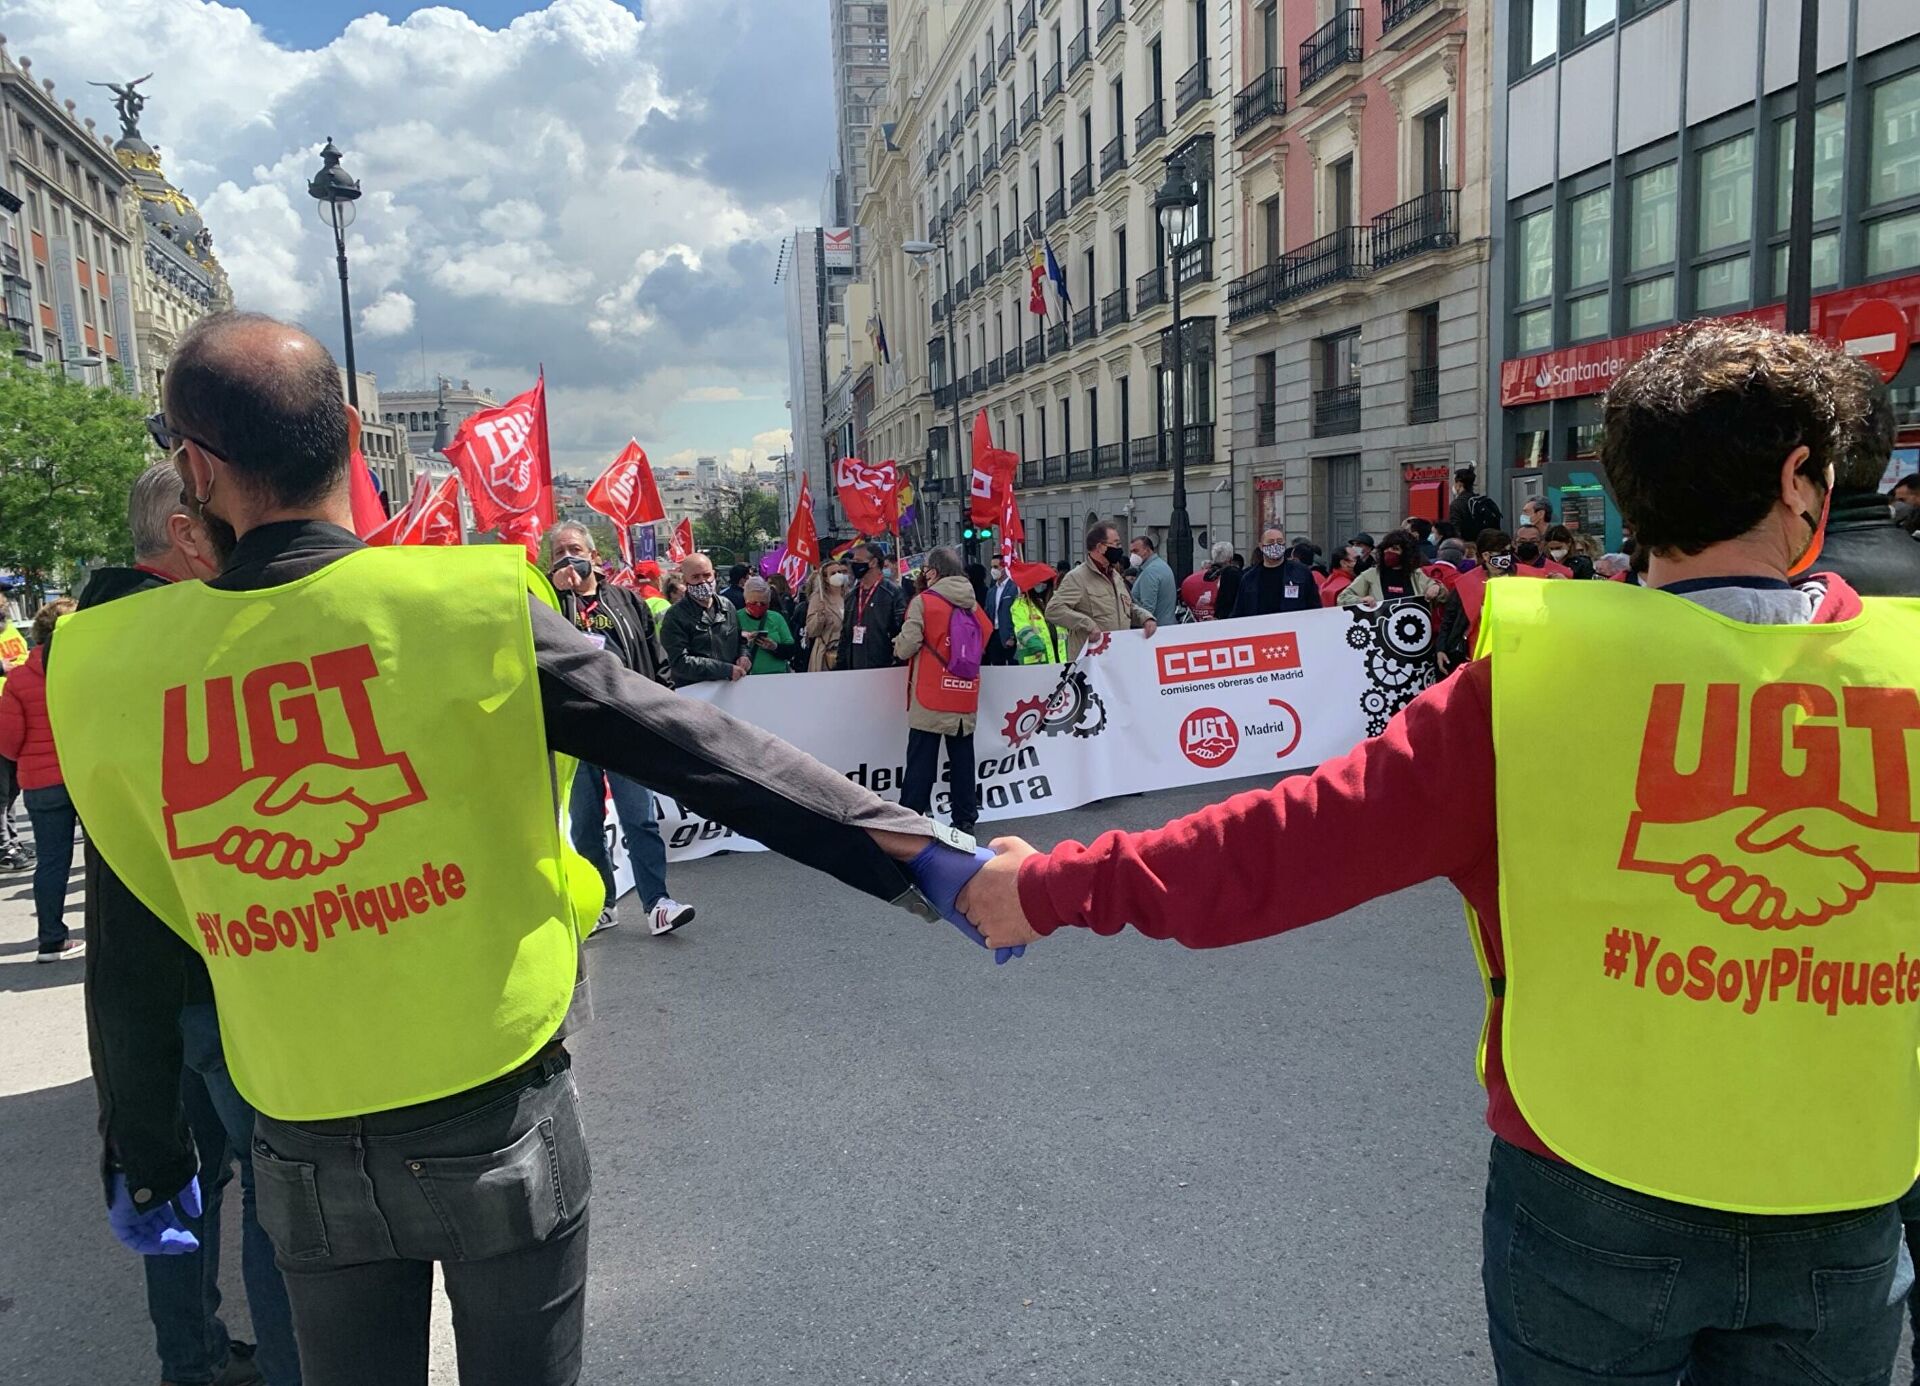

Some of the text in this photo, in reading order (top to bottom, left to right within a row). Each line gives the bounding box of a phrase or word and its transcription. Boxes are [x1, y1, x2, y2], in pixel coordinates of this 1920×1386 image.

[61, 303, 77, 343] salida
[1553, 356, 1625, 385] Santander
[1164, 644, 1256, 676] CCOO
[943, 678, 973, 689] CCOO
[1160, 669, 1304, 696] comisiones obreras de Madrid
[161, 643, 385, 806] UGT
[1186, 715, 1229, 745] UGT
[1244, 721, 1284, 737] Madrid
[977, 745, 1041, 780] con
[1635, 682, 1920, 824] UGT
[196, 862, 467, 957] #YoSoyPiquete
[1603, 926, 1920, 1017] #YoSoyPiquete
